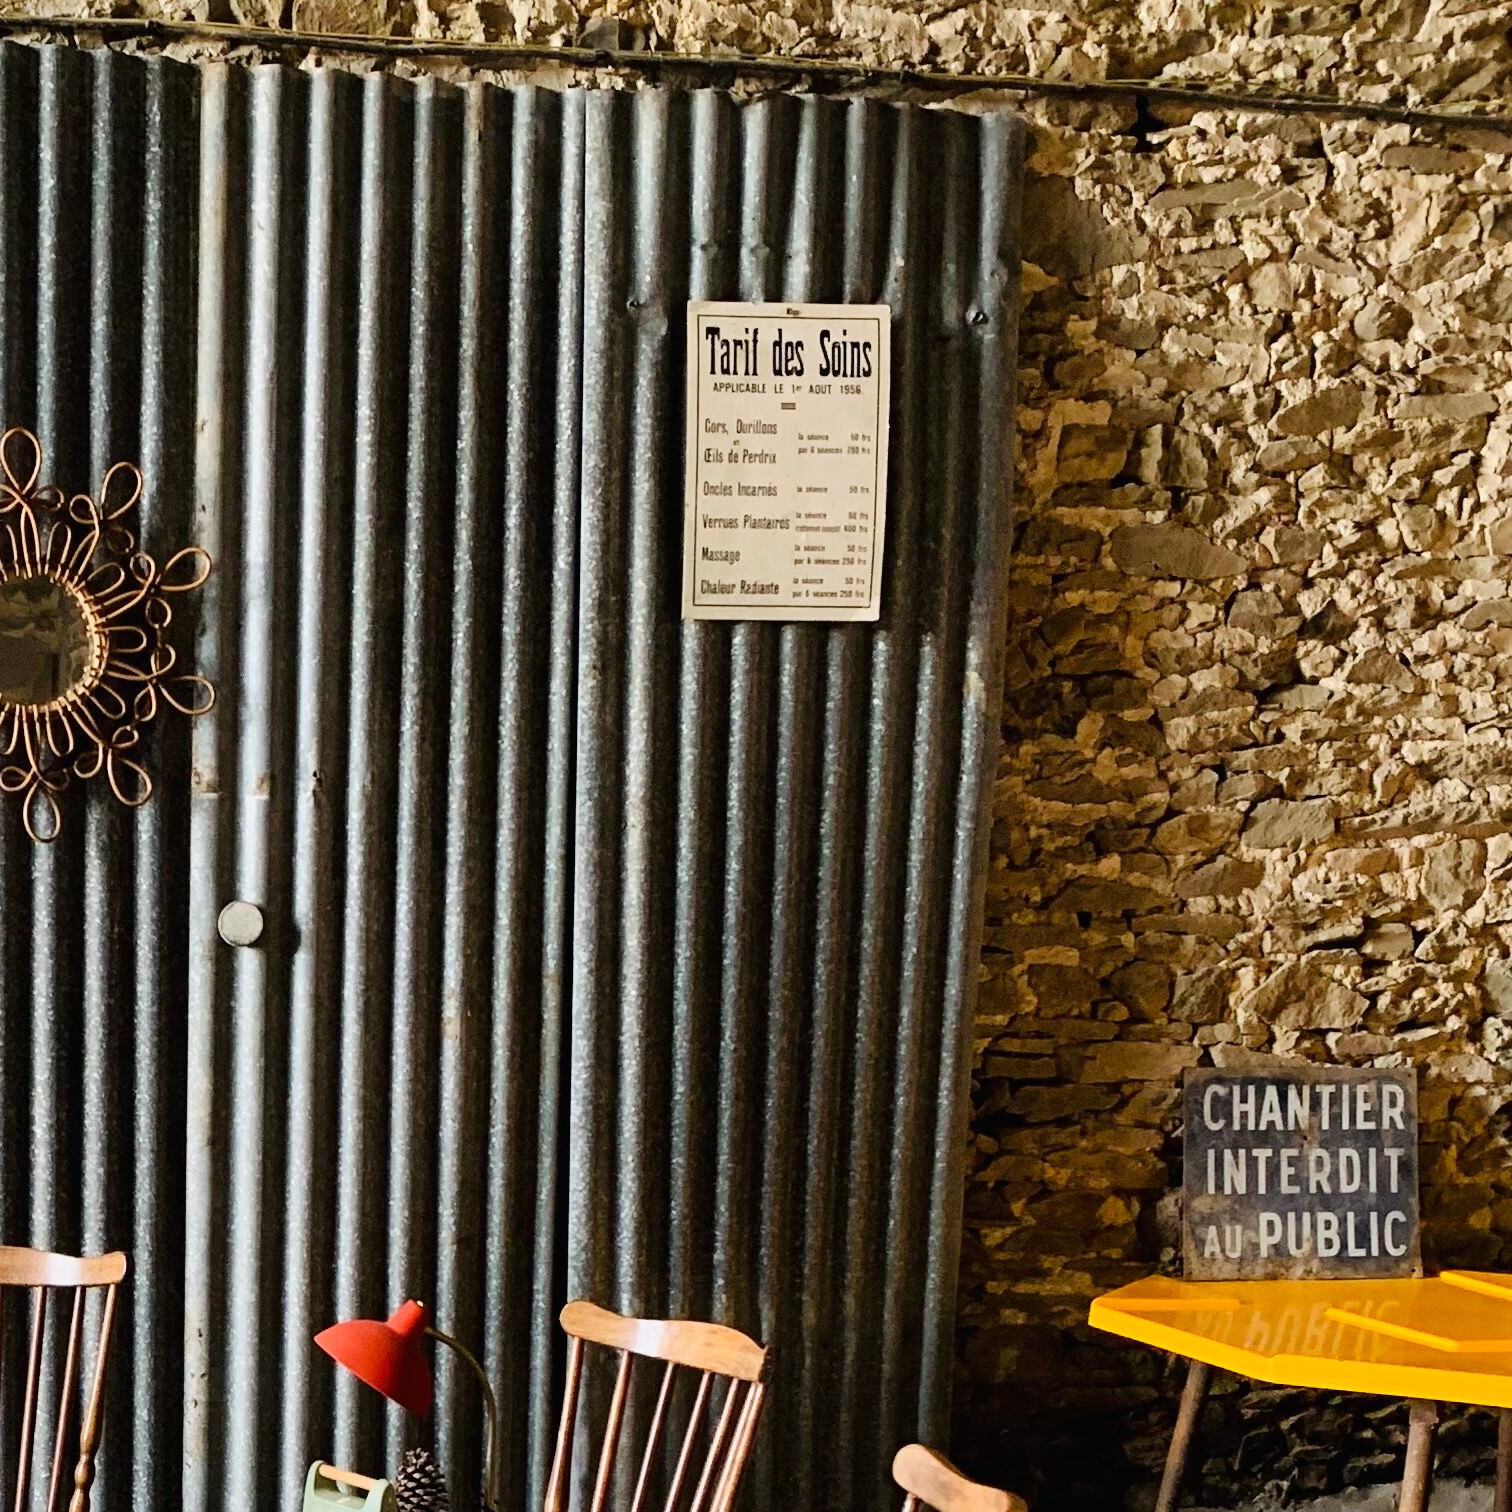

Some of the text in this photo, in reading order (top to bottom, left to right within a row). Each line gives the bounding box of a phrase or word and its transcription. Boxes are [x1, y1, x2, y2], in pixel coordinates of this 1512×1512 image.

[705, 326, 872, 378] Tarif des Soins
[712, 381, 767, 394] APPLICABLE
[774, 383, 785, 394] LE
[808, 384, 833, 395] AOUT
[736, 418, 778, 435] Durillons
[727, 449, 739, 464] de
[742, 448, 777, 464] Perdrix
[737, 481, 778, 497] Incarnés
[702, 513, 739, 530] Verrues
[701, 547, 741, 566] Massage
[700, 580, 780, 595] Chaleur Radiante
[1202, 1083, 1406, 1132] CHANTIER
[1206, 1146, 1406, 1196] INTERDIT
[1202, 1210, 1409, 1260] AU PUBLIC
